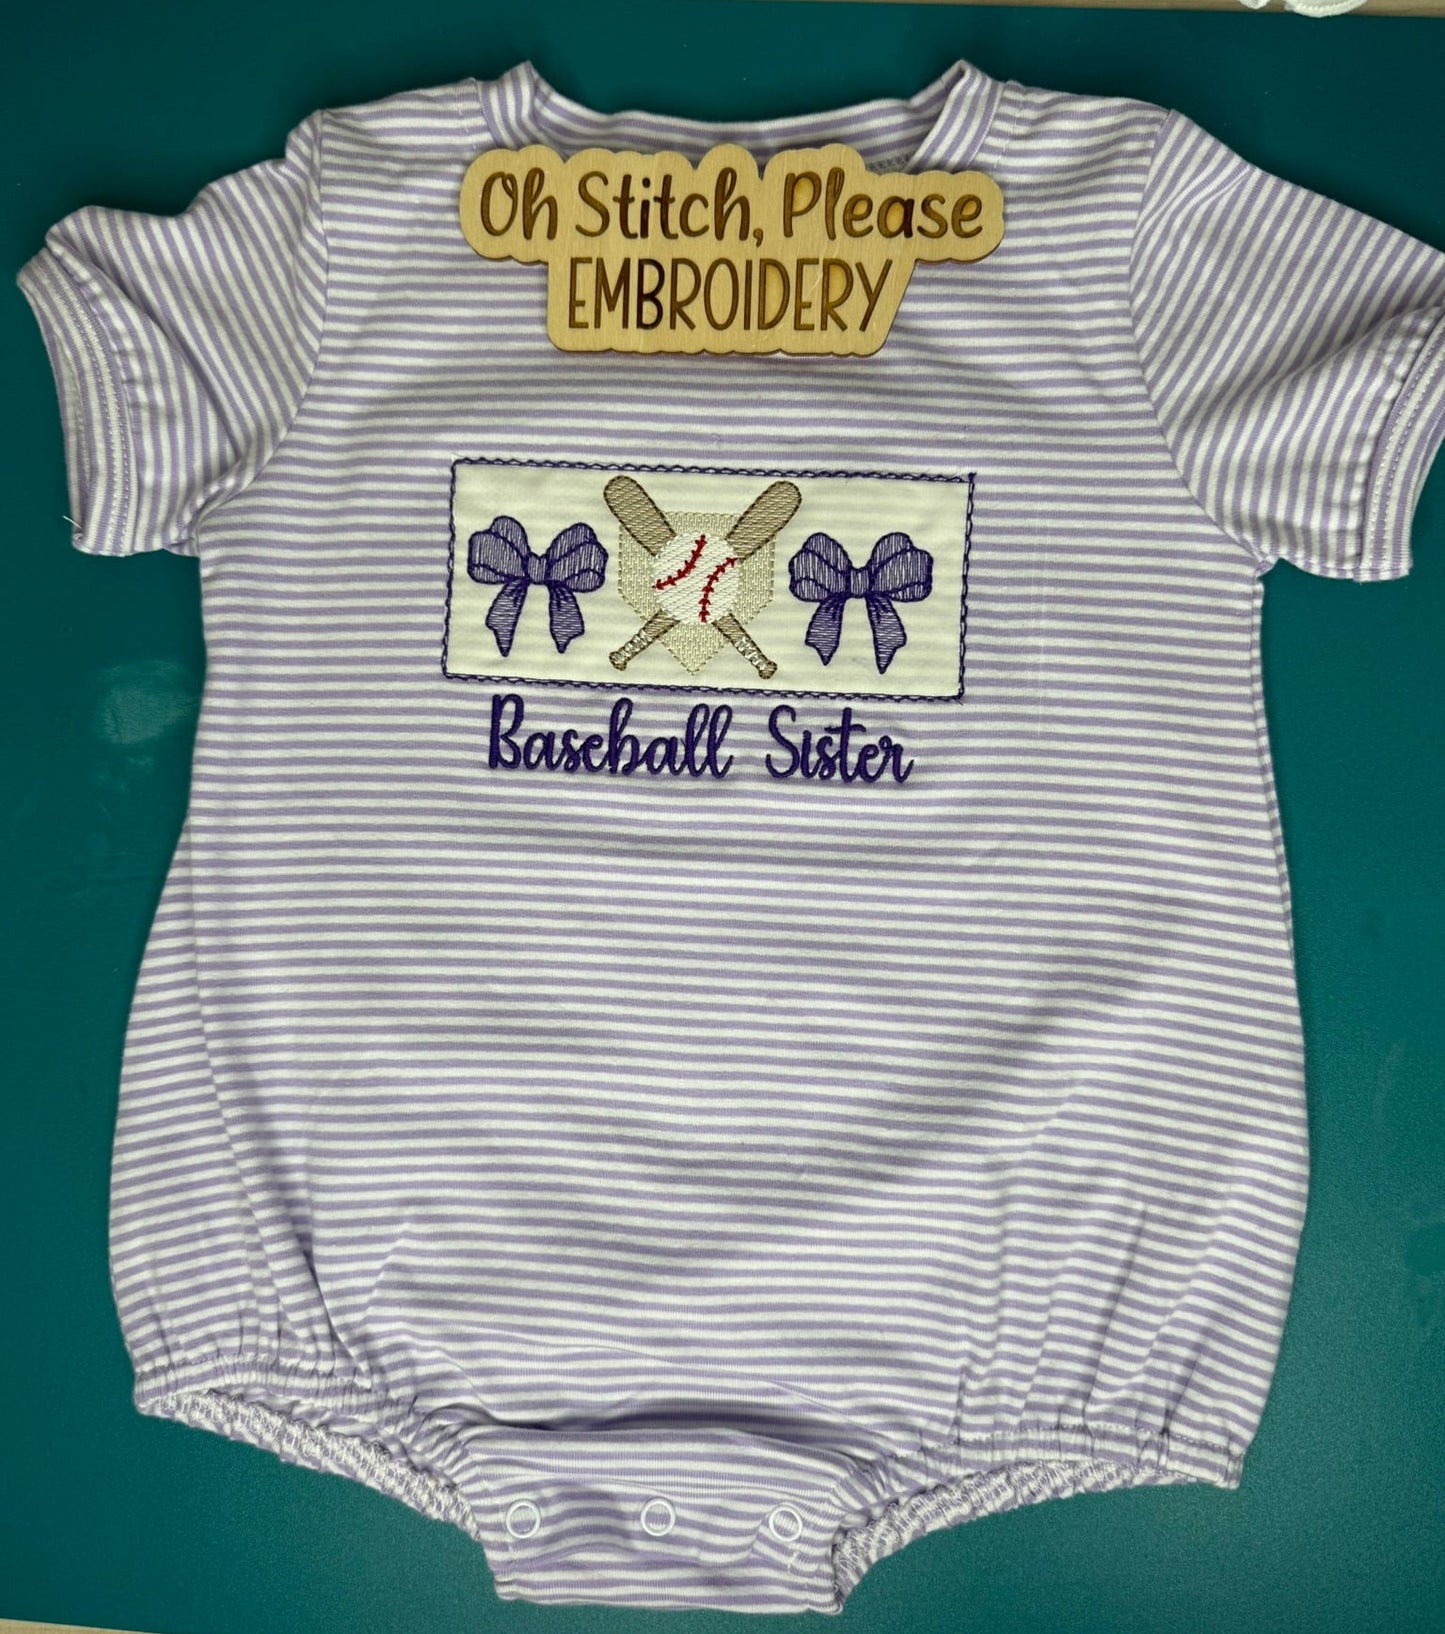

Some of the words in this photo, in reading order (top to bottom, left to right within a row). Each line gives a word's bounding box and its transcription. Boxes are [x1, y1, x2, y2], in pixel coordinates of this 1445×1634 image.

[480, 167, 559, 241] Oh
[575, 166, 764, 248] Stitch,
[783, 166, 983, 241] Please
[568, 257, 893, 332] EMBROIDERY
[488, 693, 734, 779] Baseball
[765, 704, 915, 783] Sister
